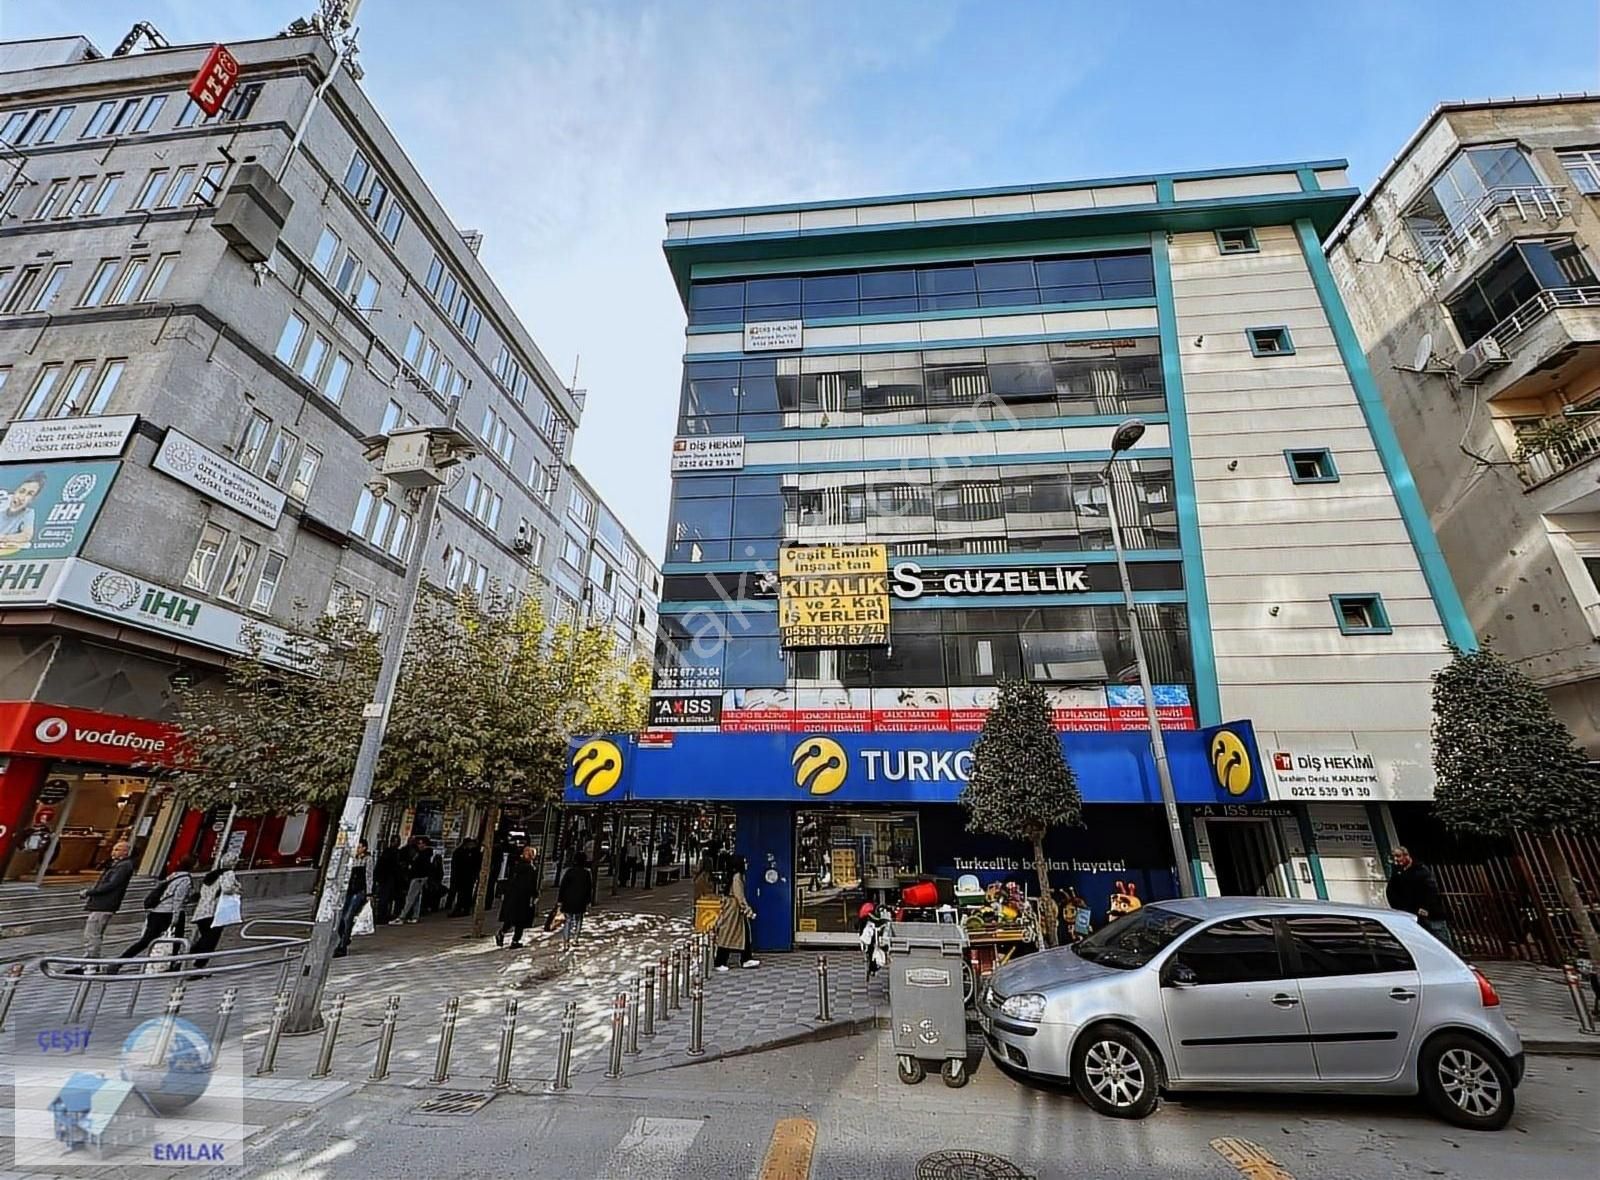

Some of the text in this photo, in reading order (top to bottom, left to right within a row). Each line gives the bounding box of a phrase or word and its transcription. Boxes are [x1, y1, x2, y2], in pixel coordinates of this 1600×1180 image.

[831, 547, 879, 559] Emlak
[781, 576, 887, 598] KİRALIK
[943, 566, 1090, 593] GÜZELLİK
[805, 600, 825, 609] ve
[830, 598, 846, 609] 2.
[852, 596, 882, 608] Kat
[785, 626, 817, 636] 0533
[785, 636, 817, 647] 0546
[75, 729, 165, 751] vodafone
[861, 750, 976, 781] TURKC
[1297, 754, 1374, 772] DİŞ HEKİMİ
[1291, 786, 1317, 797] 0212
[1341, 786, 1355, 797] 91
[953, 857, 1019, 871] Turkcell'le
[1073, 858, 1127, 875] hayata!
